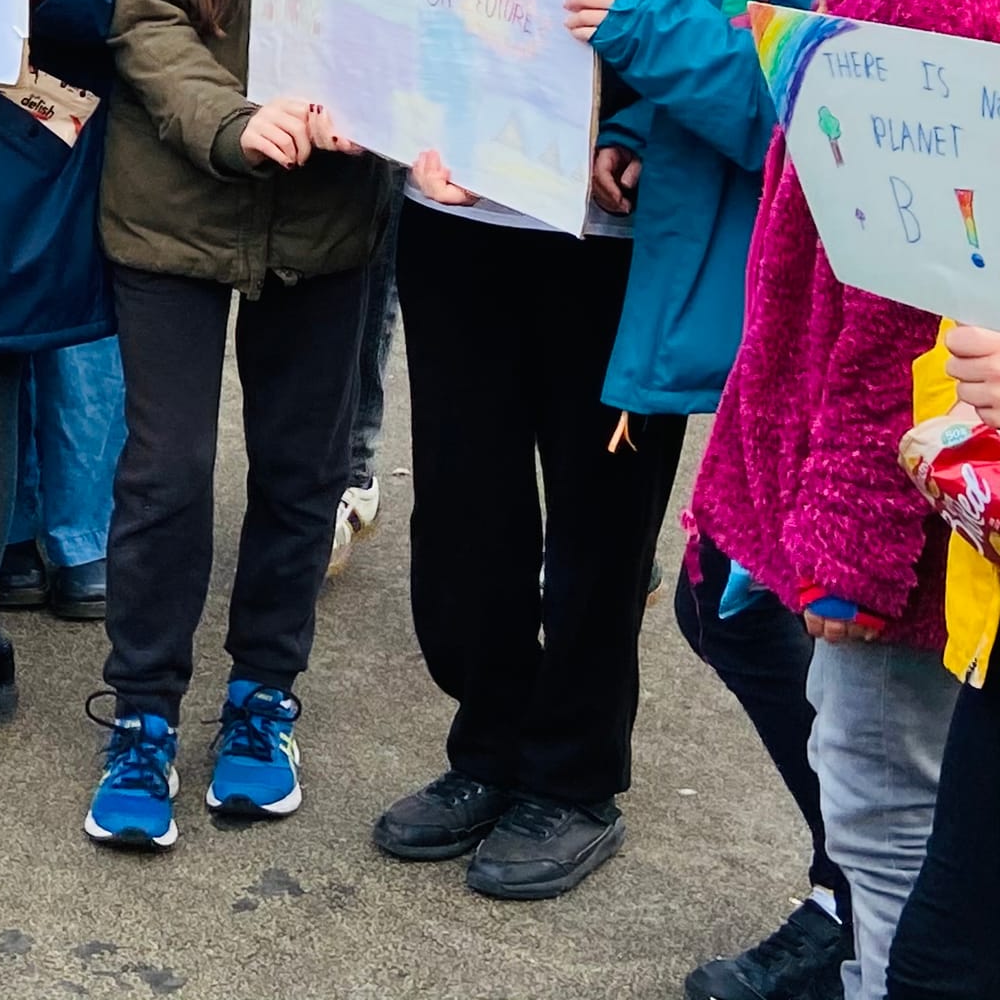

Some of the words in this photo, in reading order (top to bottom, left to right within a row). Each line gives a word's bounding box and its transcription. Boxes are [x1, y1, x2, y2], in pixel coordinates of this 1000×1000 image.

[823, 51, 888, 82] THERE
[921, 61, 951, 99] IS
[871, 113, 965, 159] PLANET
